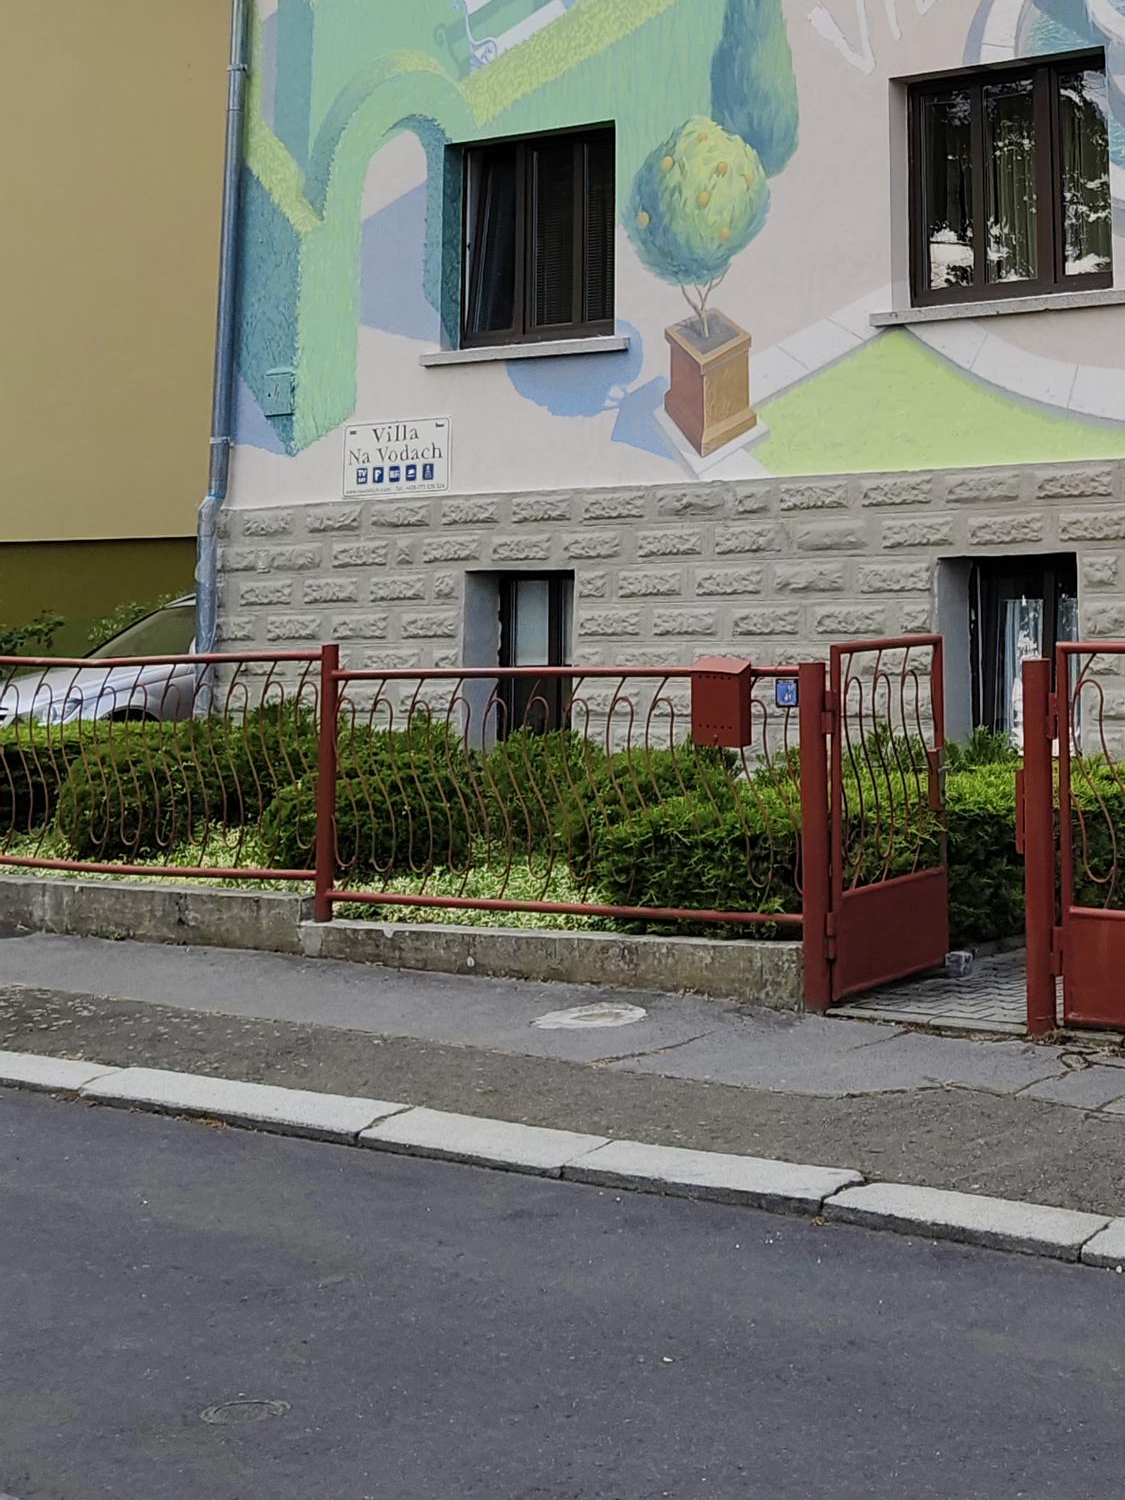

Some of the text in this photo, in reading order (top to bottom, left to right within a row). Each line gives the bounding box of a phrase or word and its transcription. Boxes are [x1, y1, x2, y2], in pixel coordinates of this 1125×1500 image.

[372, 424, 420, 443] Villa
[348, 442, 443, 466] Na Vodach
